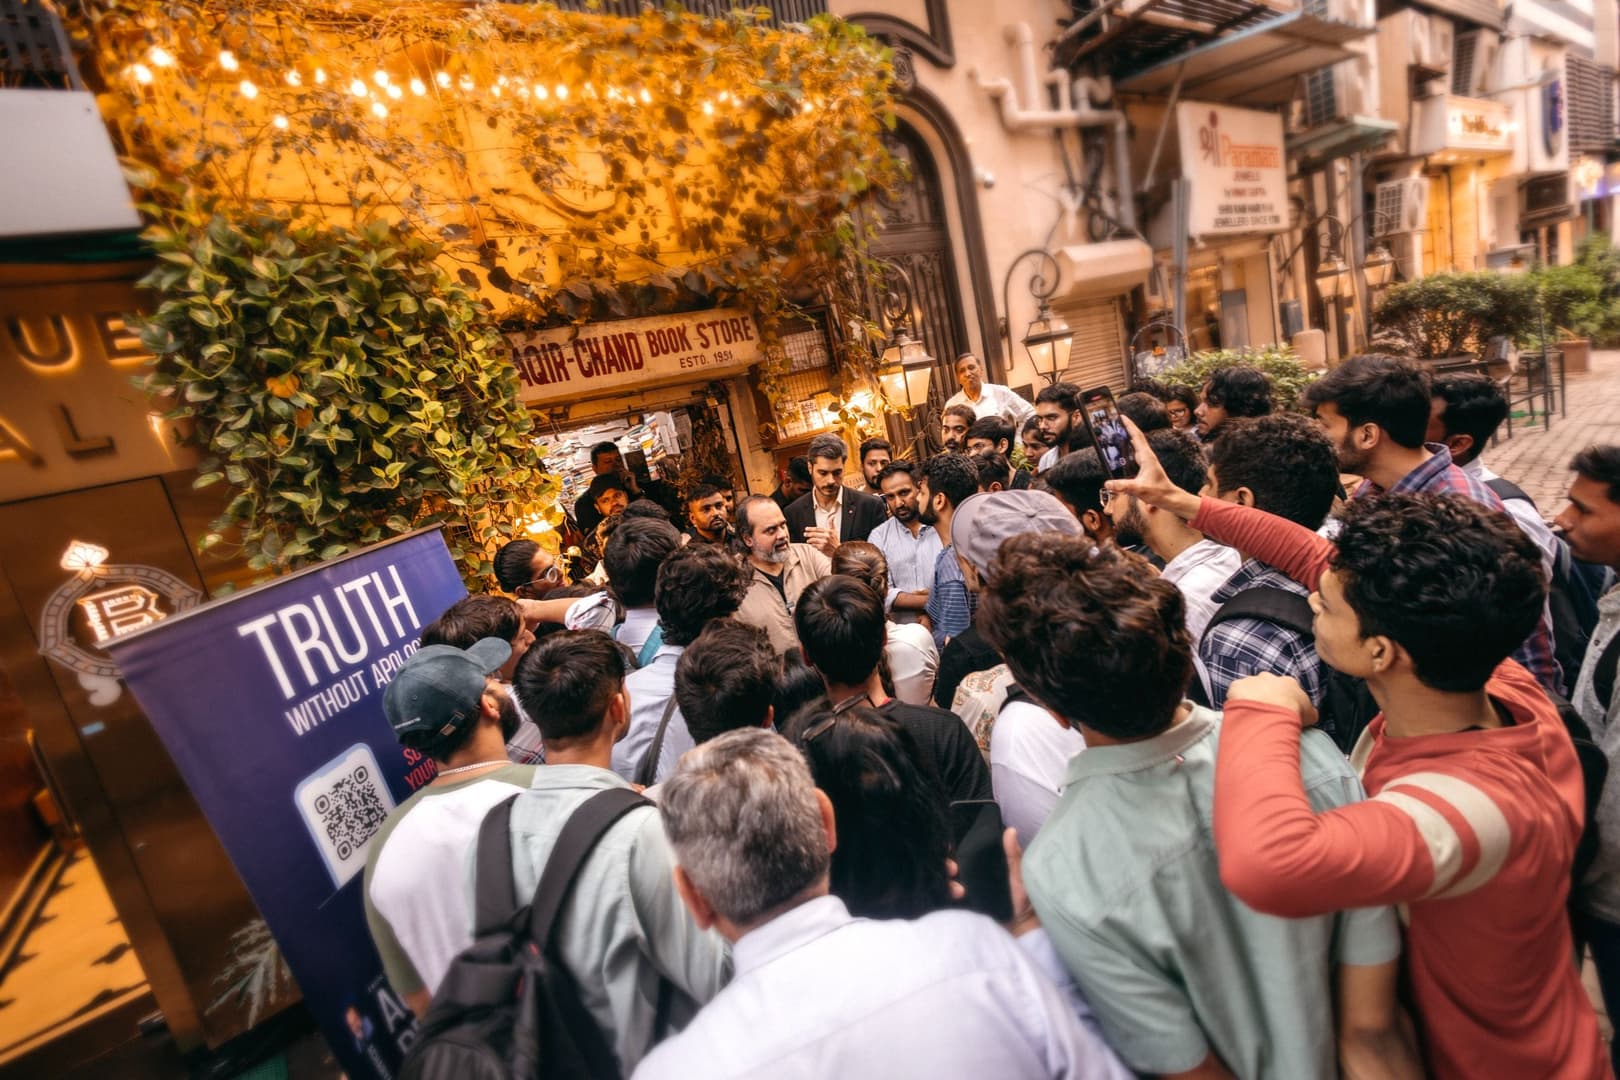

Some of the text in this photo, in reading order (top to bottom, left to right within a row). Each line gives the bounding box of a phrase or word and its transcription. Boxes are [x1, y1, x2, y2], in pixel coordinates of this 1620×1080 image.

[511, 316, 754, 387] AQIR-CHAND BOOK STORE
[714, 350, 733, 363] 1951
[237, 564, 421, 701] TRUTH
[284, 669, 370, 737] WITHOUT
[404, 758, 438, 791] YOUR
